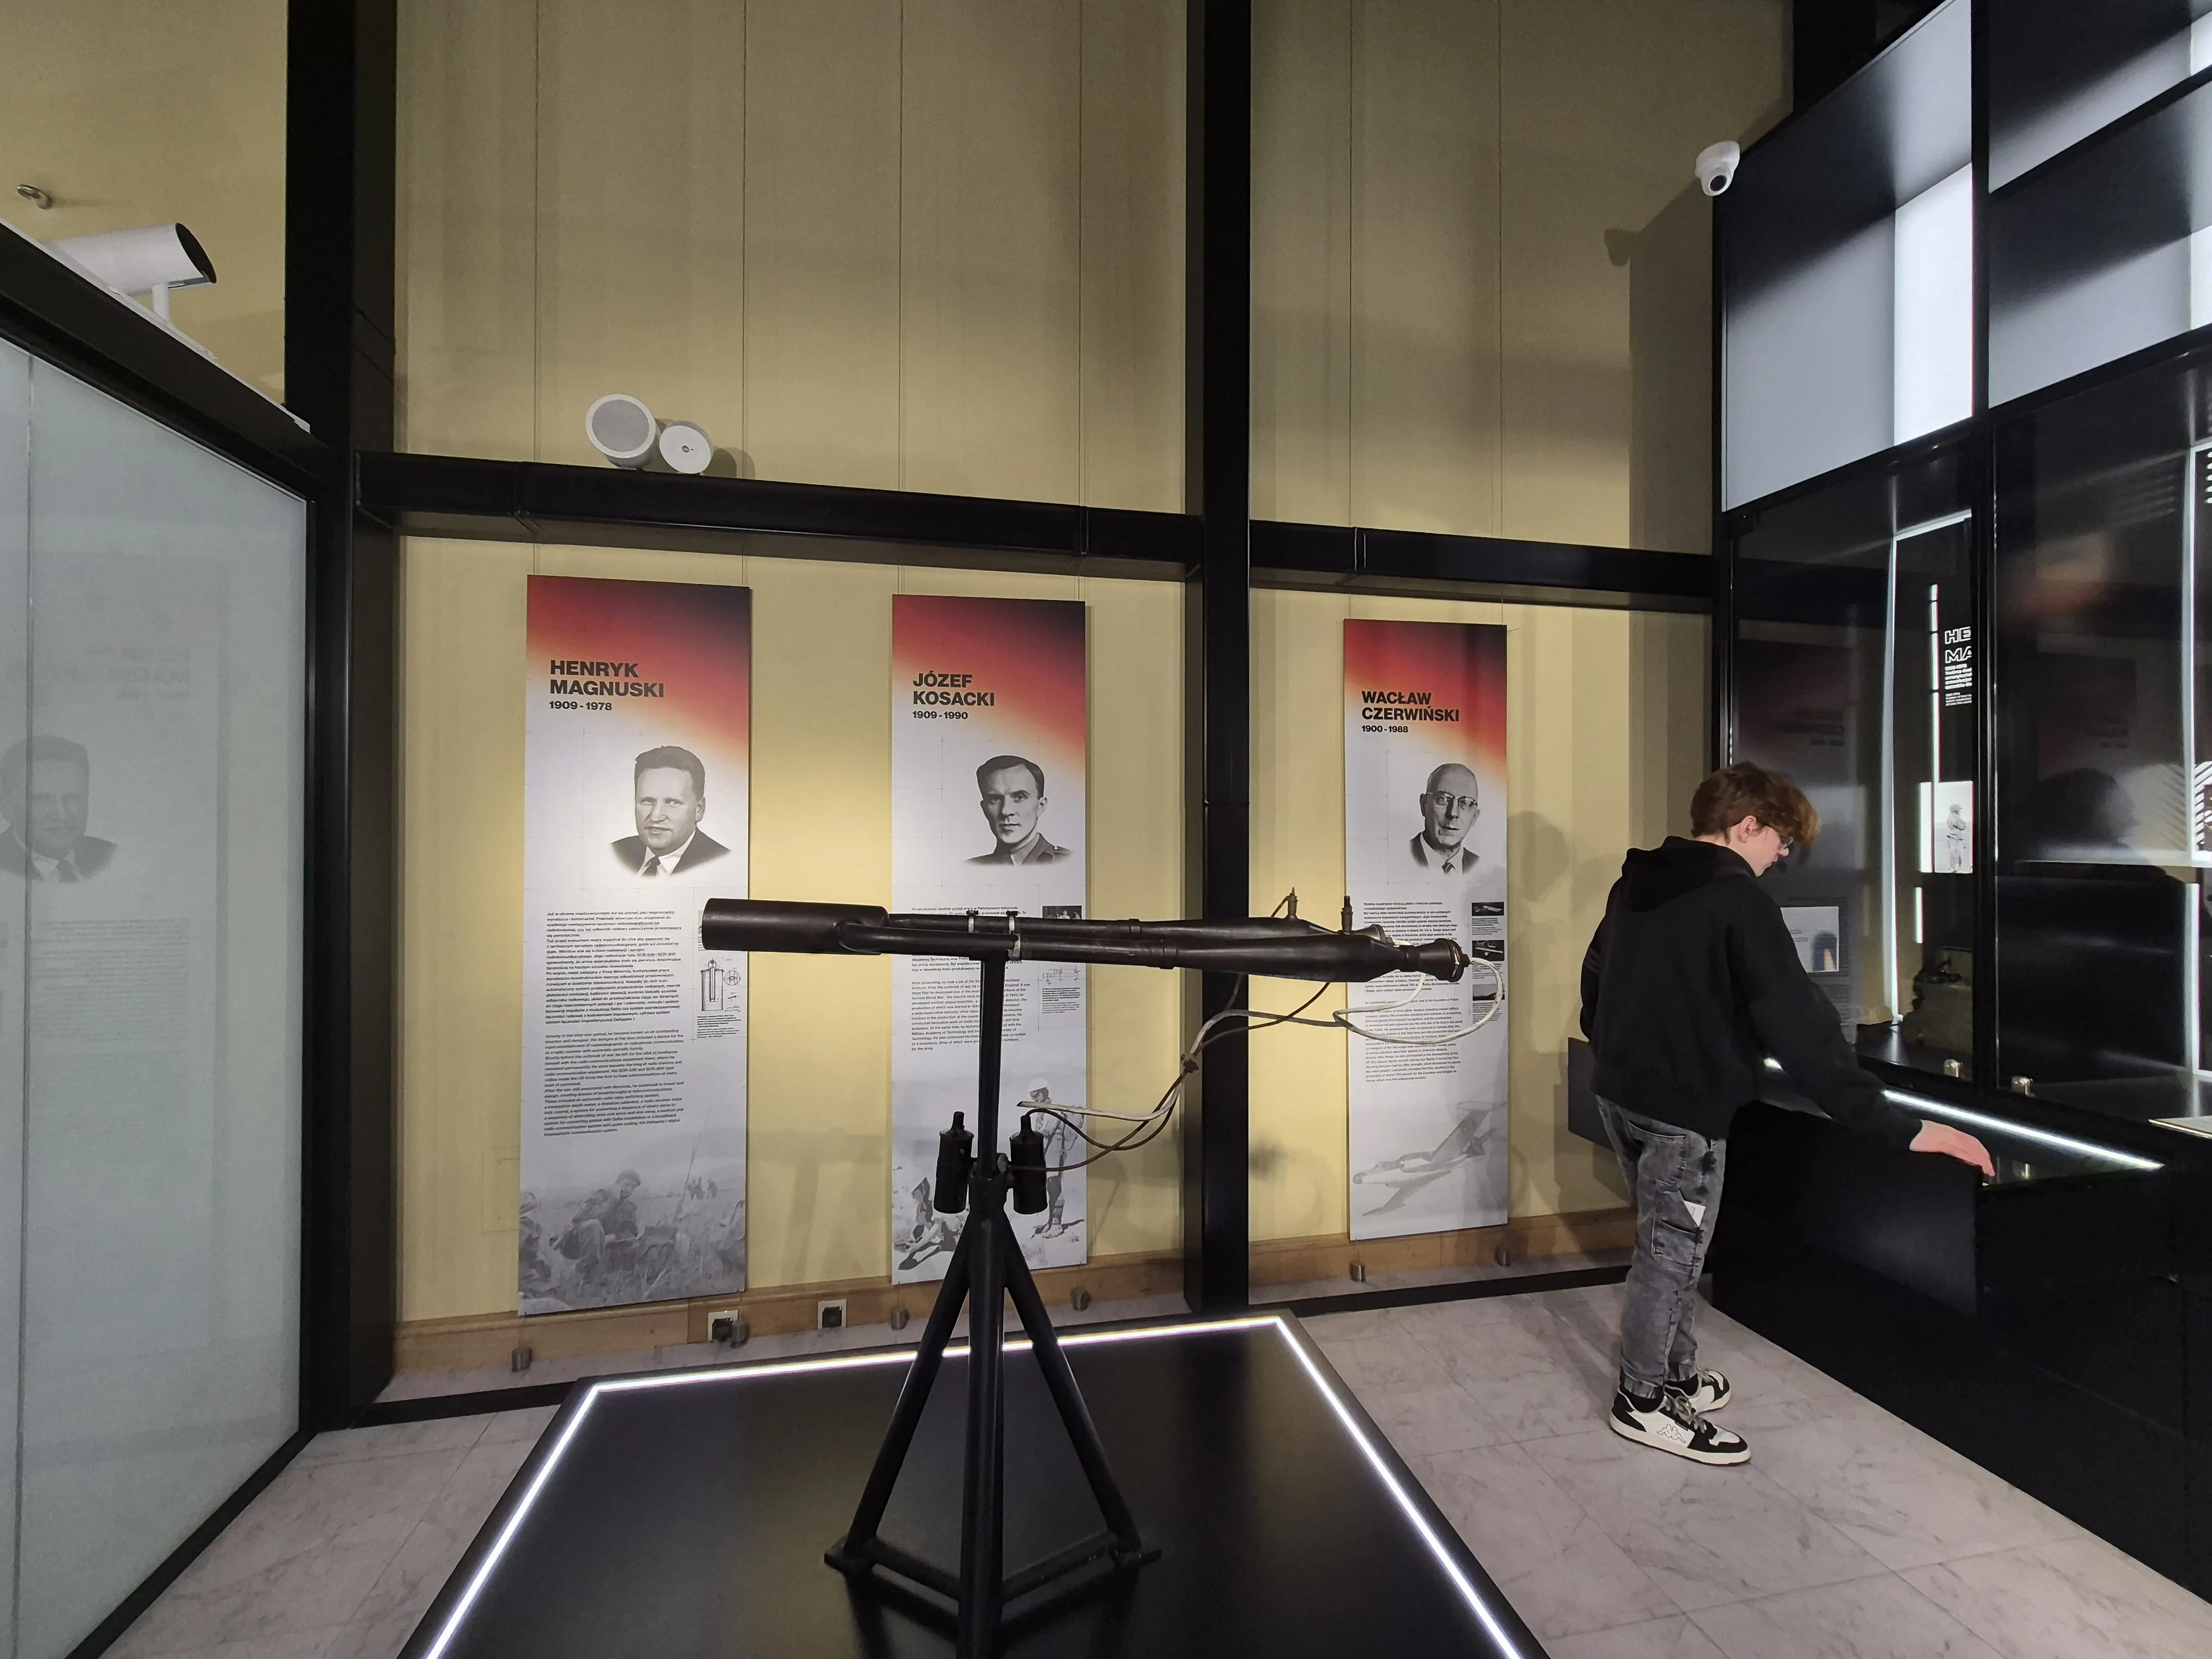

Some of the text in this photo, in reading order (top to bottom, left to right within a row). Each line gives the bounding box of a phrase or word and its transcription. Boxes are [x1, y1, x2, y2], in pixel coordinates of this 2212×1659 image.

[550, 659, 639, 678] HENRYK
[913, 670, 972, 688] JÓZEF
[550, 679, 664, 698] MAGNUSKI
[913, 691, 995, 706] KOSACKI
[1361, 690, 1432, 705] WACŁAW
[1362, 706, 1459, 722] CZERWIŃSKI
